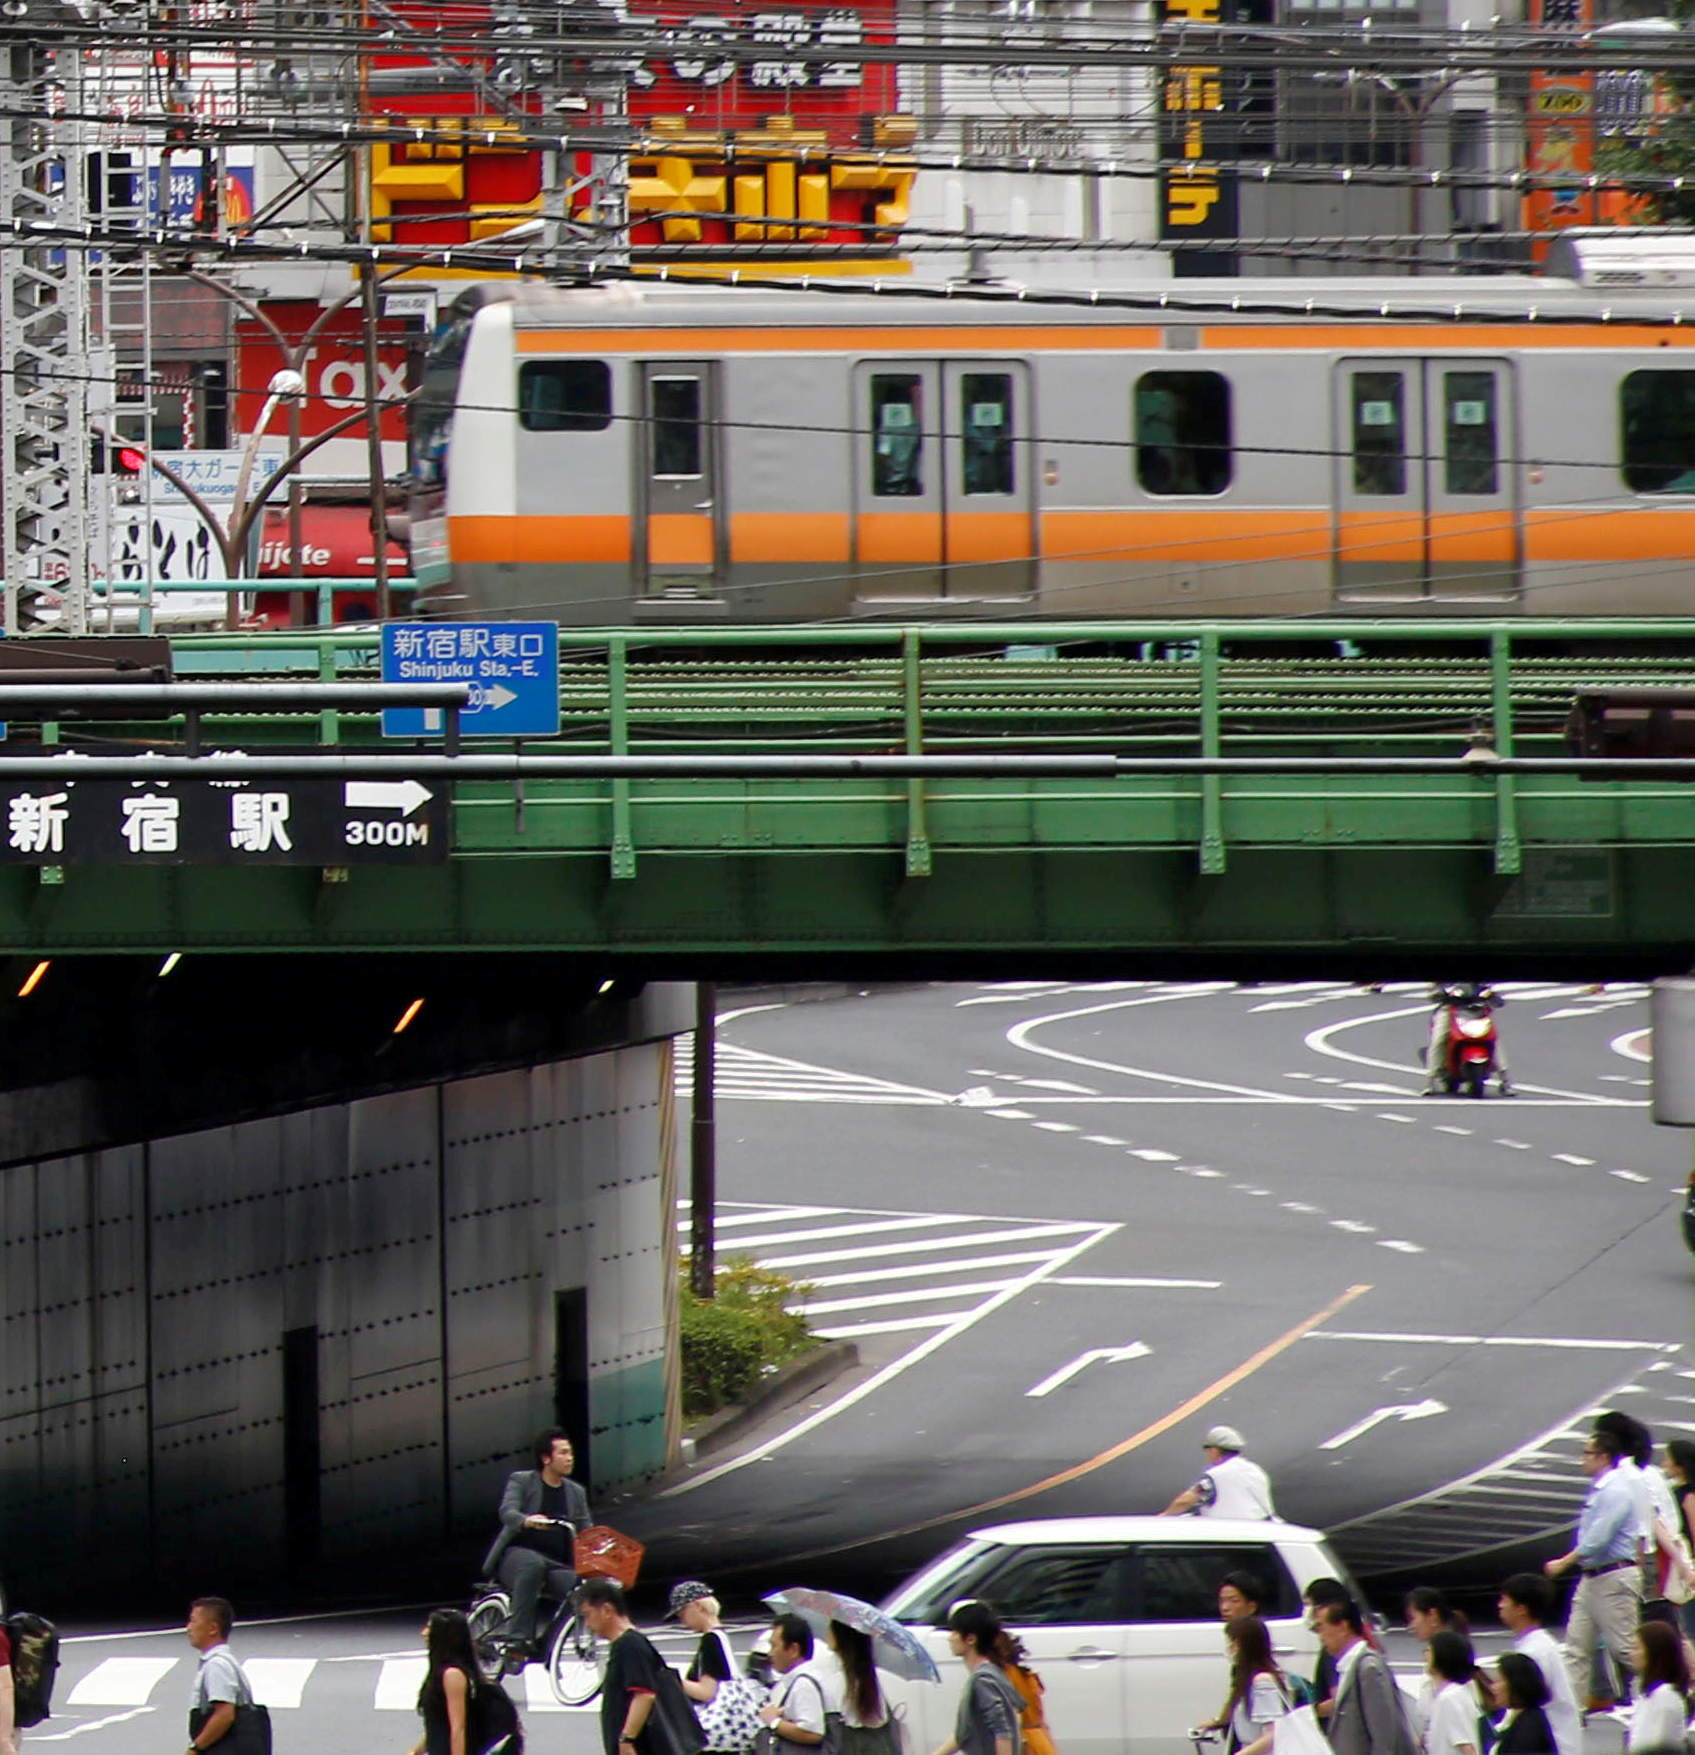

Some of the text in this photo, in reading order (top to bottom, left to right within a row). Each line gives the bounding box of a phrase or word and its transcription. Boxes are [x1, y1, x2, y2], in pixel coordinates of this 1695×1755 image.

[394, 628, 544, 659] 新宿駅東口
[399, 660, 475, 679] Shinjuku
[8, 792, 292, 854] 新宿駅
[345, 819, 428, 846] 300M
